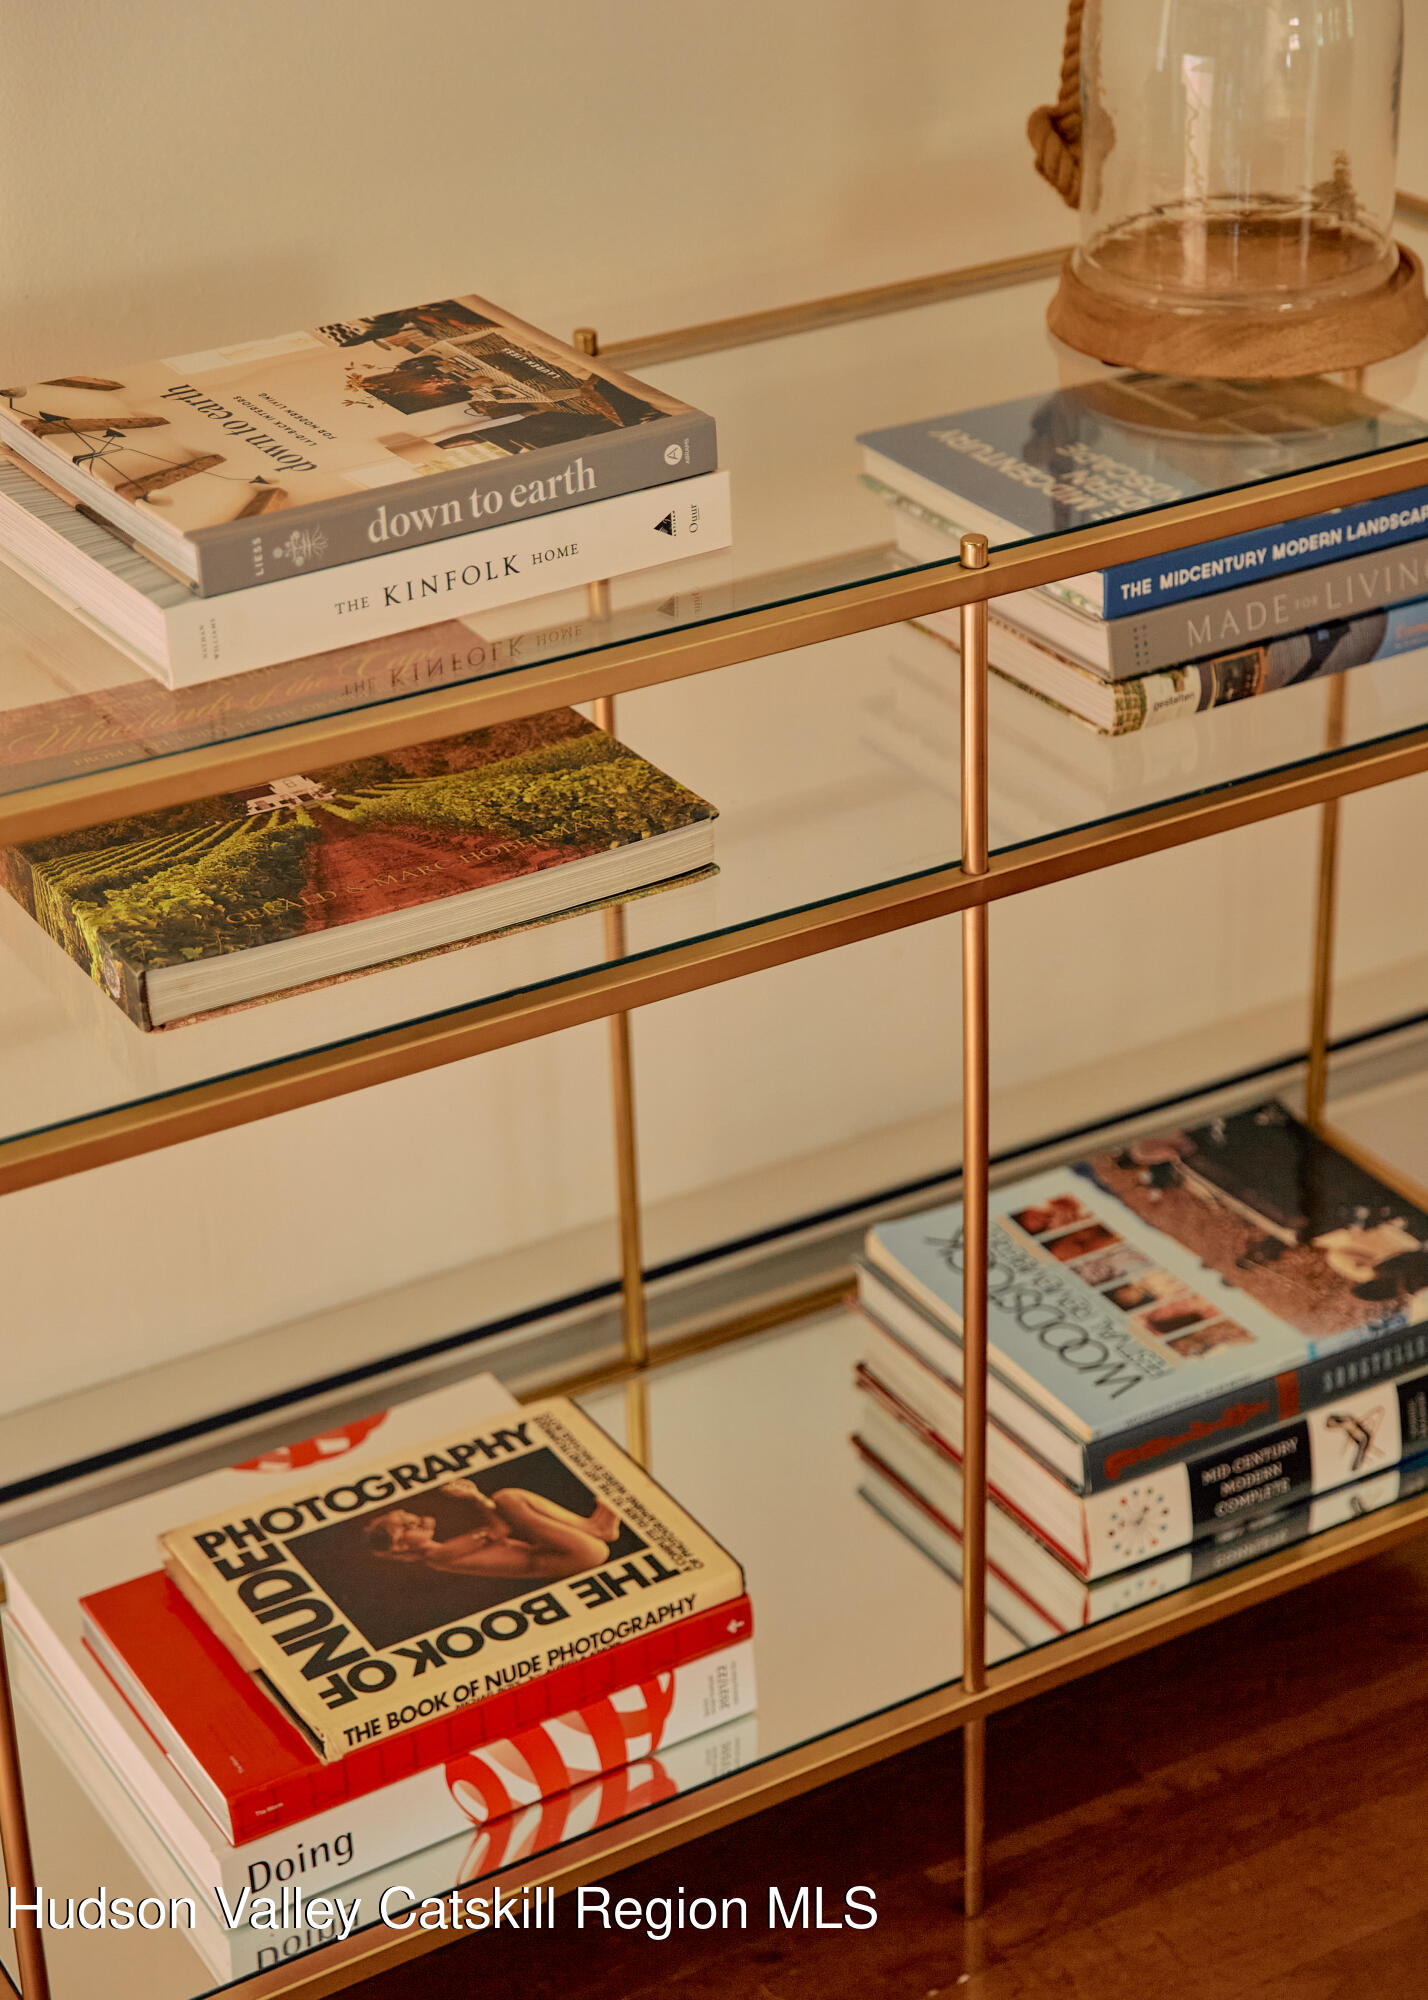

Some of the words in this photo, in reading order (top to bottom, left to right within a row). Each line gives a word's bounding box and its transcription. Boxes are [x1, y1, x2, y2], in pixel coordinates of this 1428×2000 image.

[159, 383, 234, 421] earth
[232, 394, 274, 422] INTERIORS
[257, 391, 288, 410] LIVING
[286, 407, 320, 430] MODERN
[221, 418, 258, 437] to
[274, 420, 319, 448] LAID-BACK
[316, 427, 338, 441] FOR
[245, 433, 319, 473] down
[368, 499, 463, 544] down
[469, 487, 504, 519] to
[509, 456, 598, 508] earth
[1059, 468, 1151, 512] DERN
[251, 536, 265, 577] LIESS
[333, 595, 371, 616] THE
[383, 554, 521, 608] KINFOLK
[530, 543, 580, 566] HOME
[1121, 577, 1152, 601] THE
[1159, 547, 1268, 591] MIDCENTURY
[1272, 528, 1342, 562] MODERN
[1187, 592, 1289, 649] MADE
[225, 888, 339, 926] GERALD
[345, 881, 368, 896] &
[373, 855, 452, 888] MARC
[459, 814, 609, 864] HOBERMAN
[192, 1421, 538, 1560] PHOTOGRAPHY
[1213, 1476, 1292, 1518] COMPLETE
[1219, 1461, 1283, 1498] MODERN
[567, 1552, 682, 1610] THE
[211, 1540, 372, 1682] NUDE
[390, 1591, 573, 1678] BOOK
[318, 1658, 398, 1711] OF
[343, 1718, 381, 1746] THE
[386, 1691, 449, 1730] BOOK
[452, 1679, 481, 1704] OF
[485, 1655, 543, 1692] NUDE
[547, 1593, 698, 1668] PHOTOGRAPHY
[248, 1831, 355, 1894] Doing
